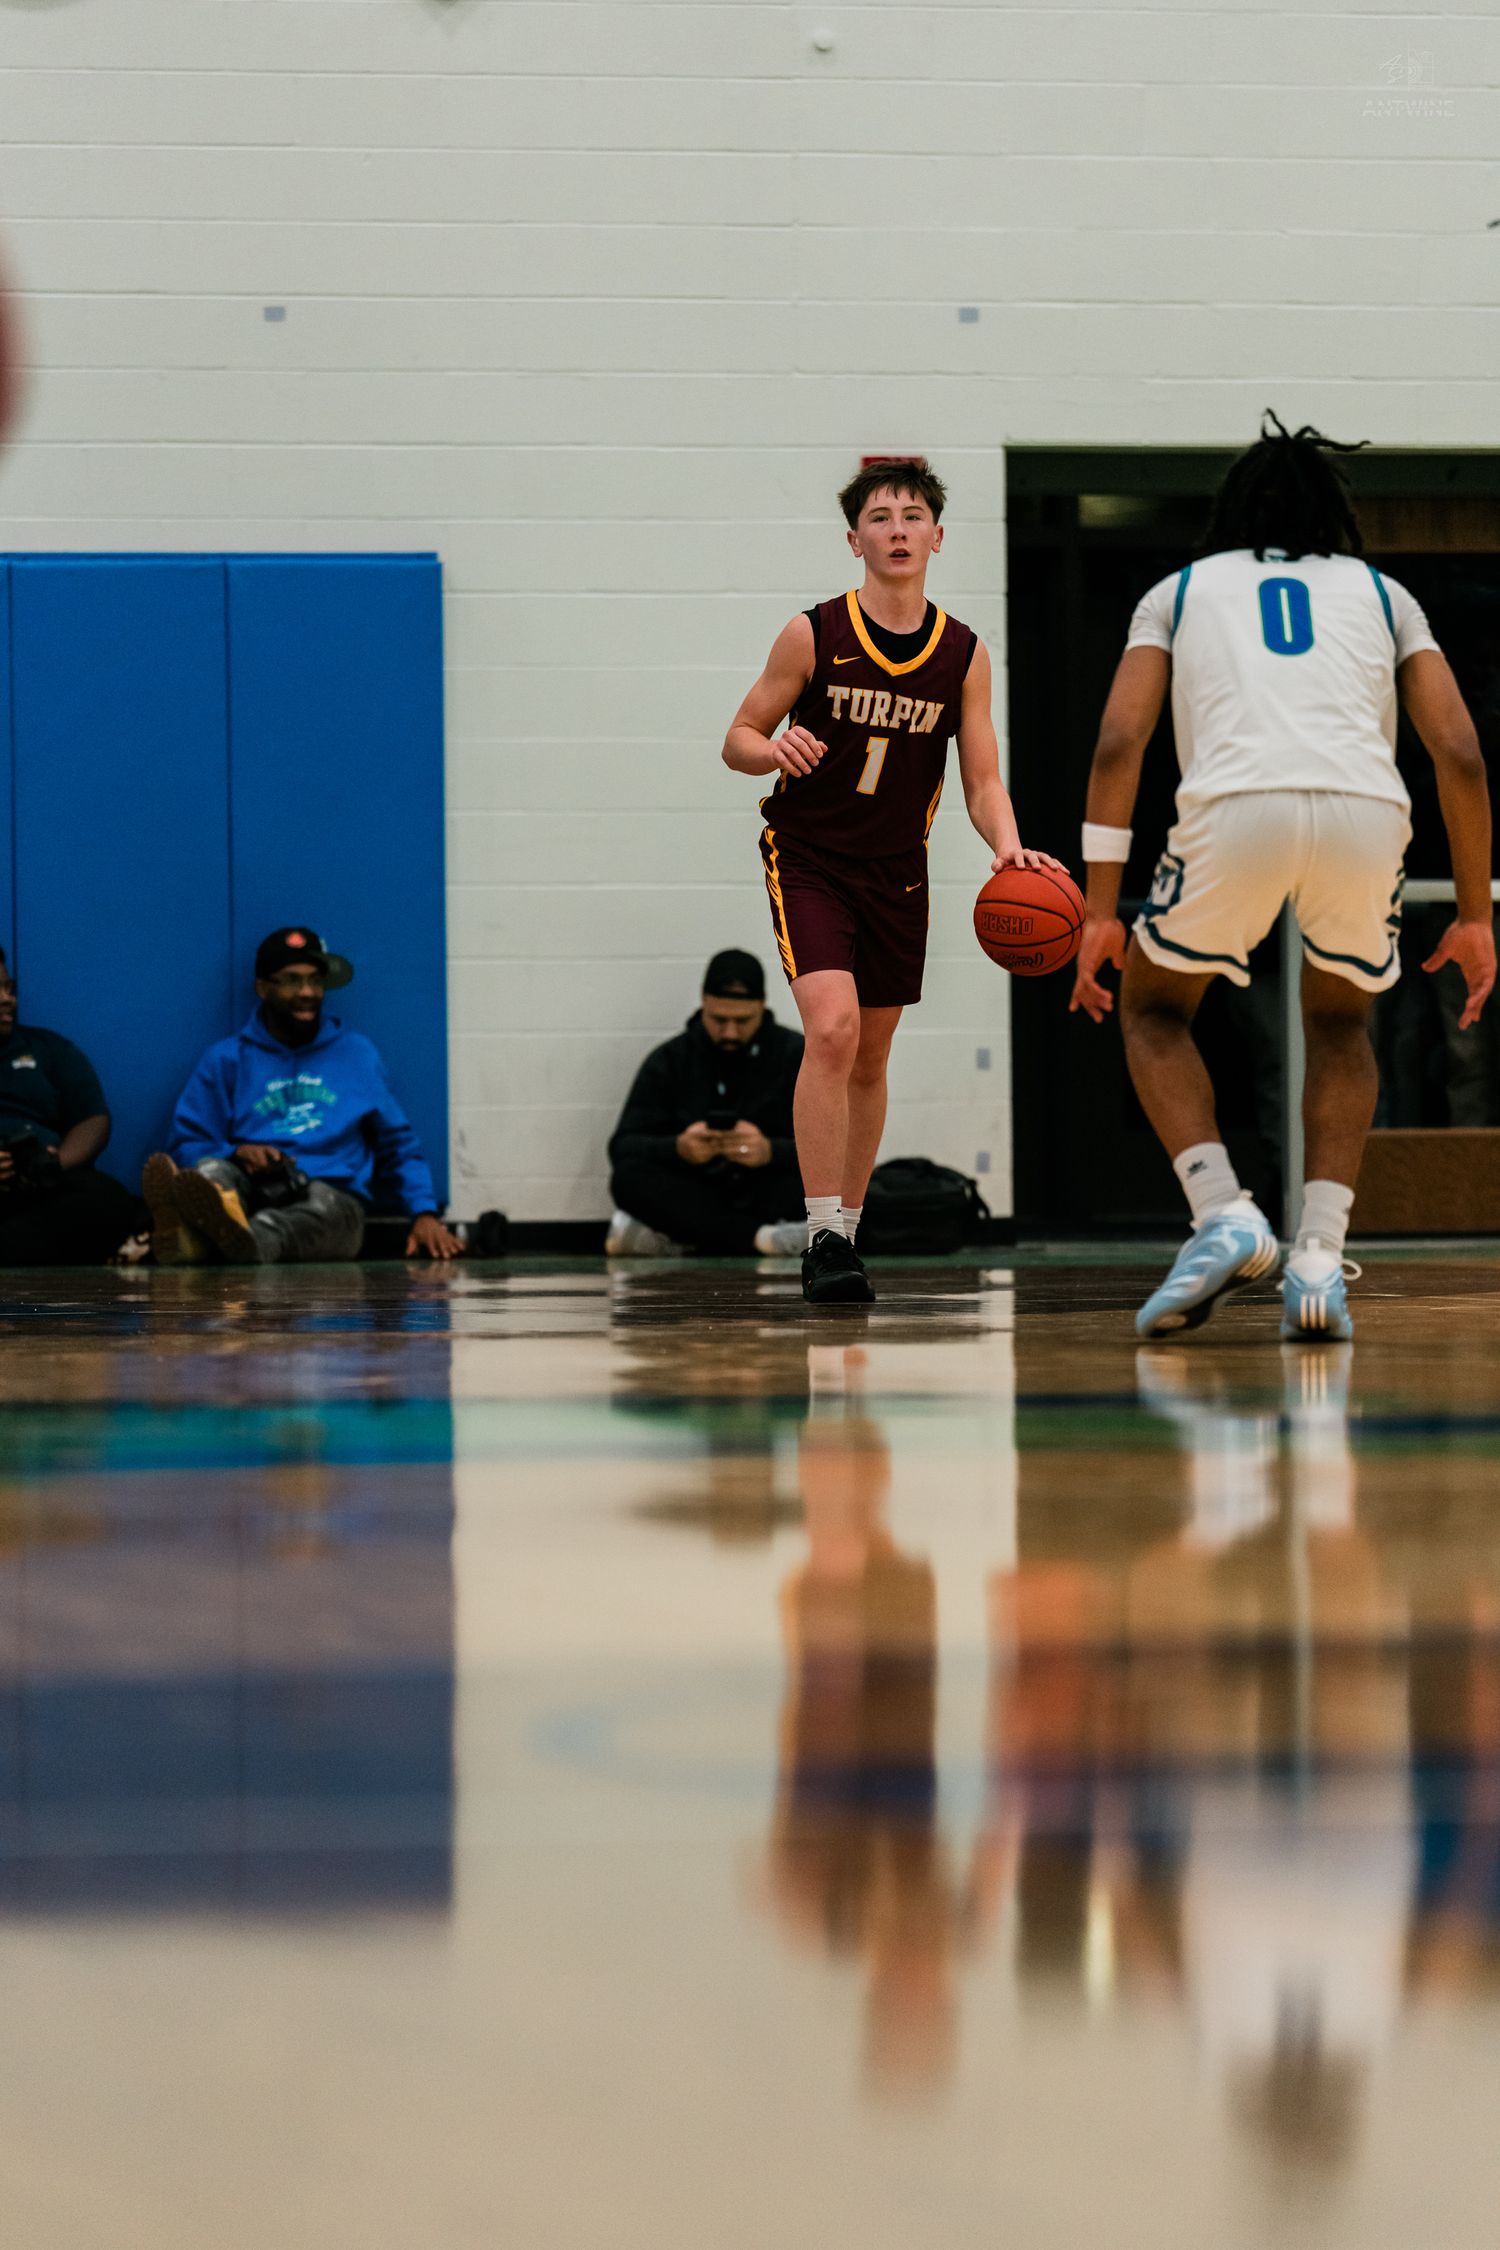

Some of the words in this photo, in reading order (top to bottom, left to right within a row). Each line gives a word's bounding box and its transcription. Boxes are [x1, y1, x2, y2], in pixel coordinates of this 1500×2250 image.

[1258, 577, 1315, 656] 0
[826, 684, 945, 734] TURPIN
[856, 736, 890, 796] 1
